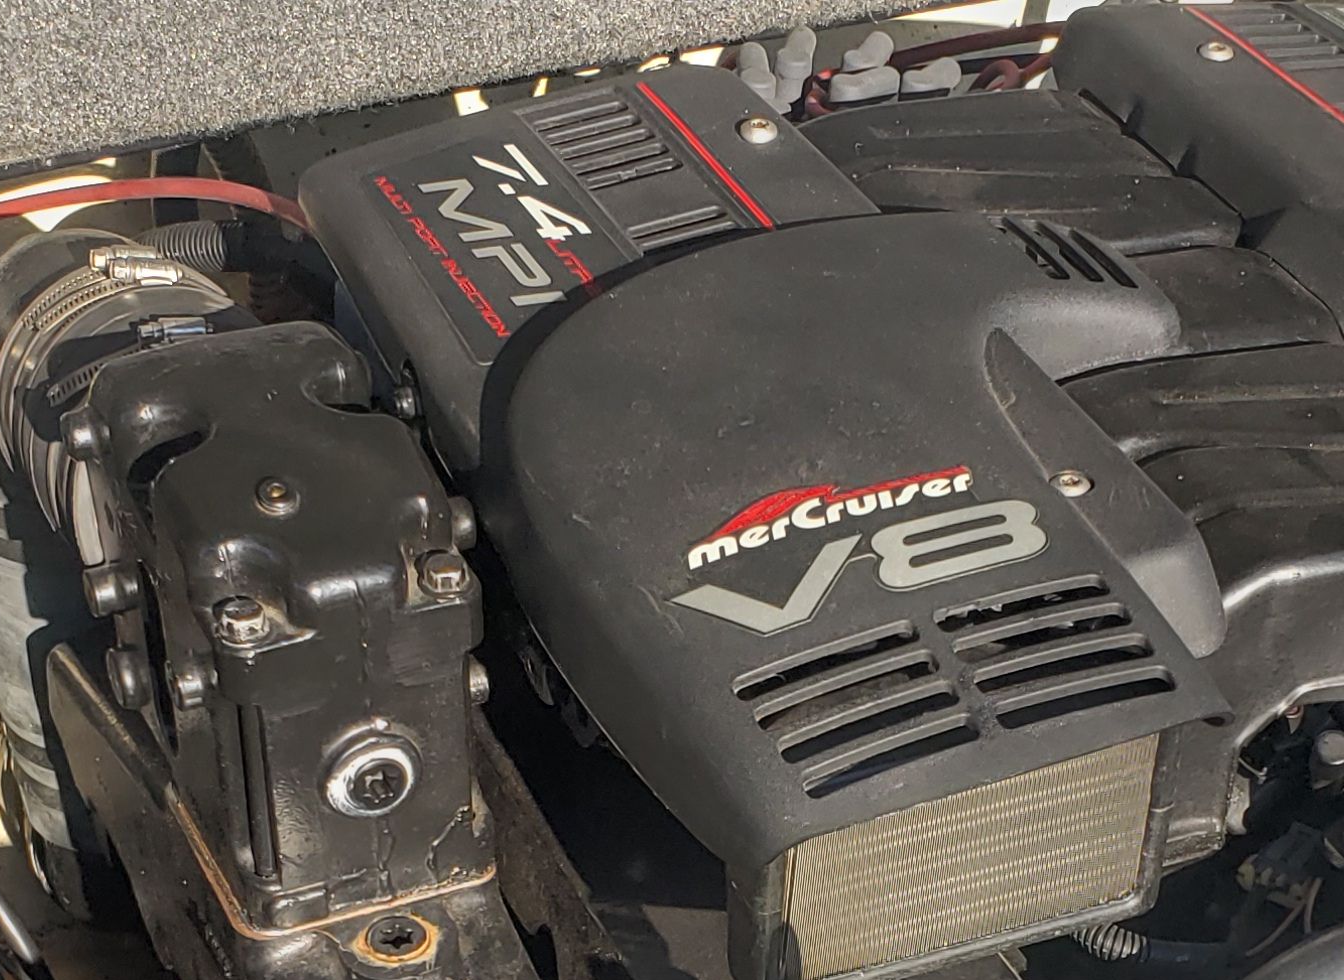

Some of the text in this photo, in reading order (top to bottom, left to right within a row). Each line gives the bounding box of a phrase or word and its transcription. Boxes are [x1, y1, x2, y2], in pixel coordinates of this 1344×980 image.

[374, 176, 413, 214] MULTI
[441, 257, 512, 339] INJECTION
[417, 179, 568, 306] MPI
[472, 144, 592, 241] 7.4
[669, 499, 1049, 637] V8
